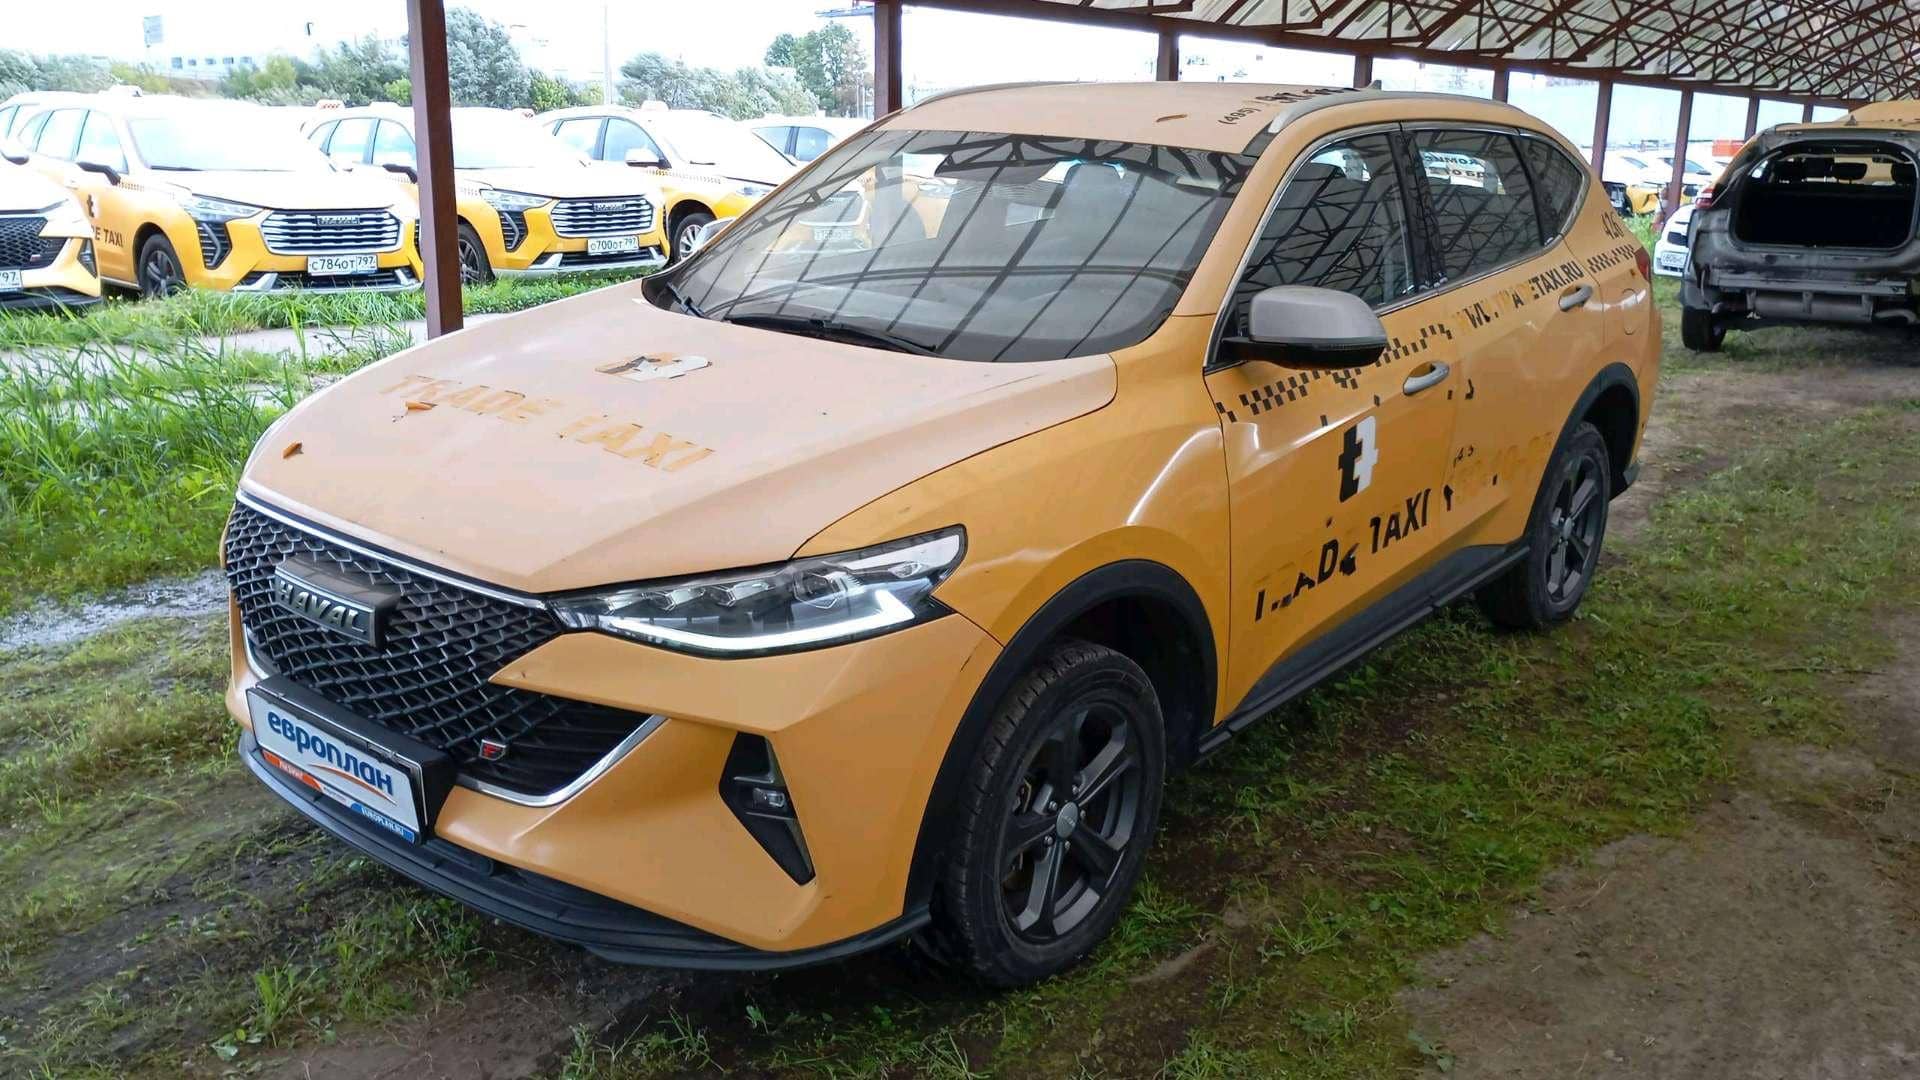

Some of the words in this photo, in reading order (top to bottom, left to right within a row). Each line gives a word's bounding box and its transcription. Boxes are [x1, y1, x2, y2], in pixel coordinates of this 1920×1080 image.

[103, 228, 124, 248] TAXI
[357, 255, 375, 266] 797
[0, 271, 17, 283] 97
[280, 579, 367, 634] HAVAL
[267, 710, 395, 797] европлан
